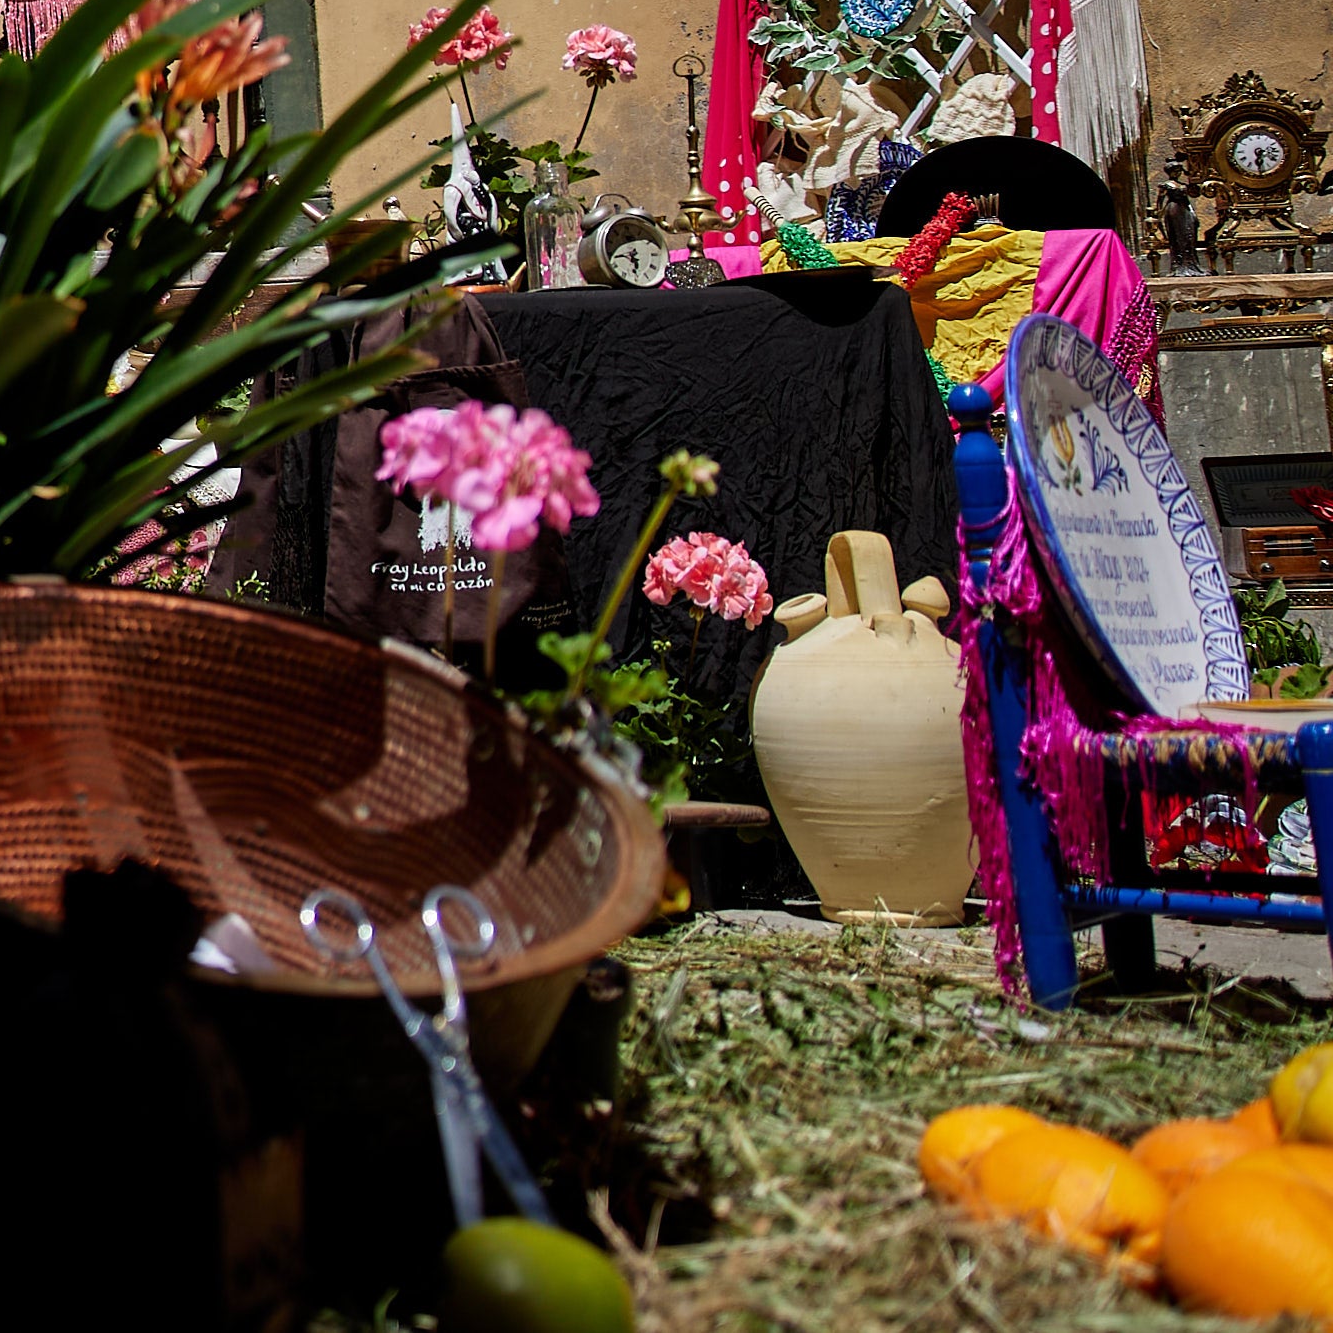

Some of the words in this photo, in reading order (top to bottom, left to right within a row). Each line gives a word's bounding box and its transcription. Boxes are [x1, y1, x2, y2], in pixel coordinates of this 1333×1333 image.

[1109, 509, 1159, 537] Granada
[371, 562, 409, 582] Fray
[391, 582, 406, 592] en
[410, 581, 424, 591] mi
